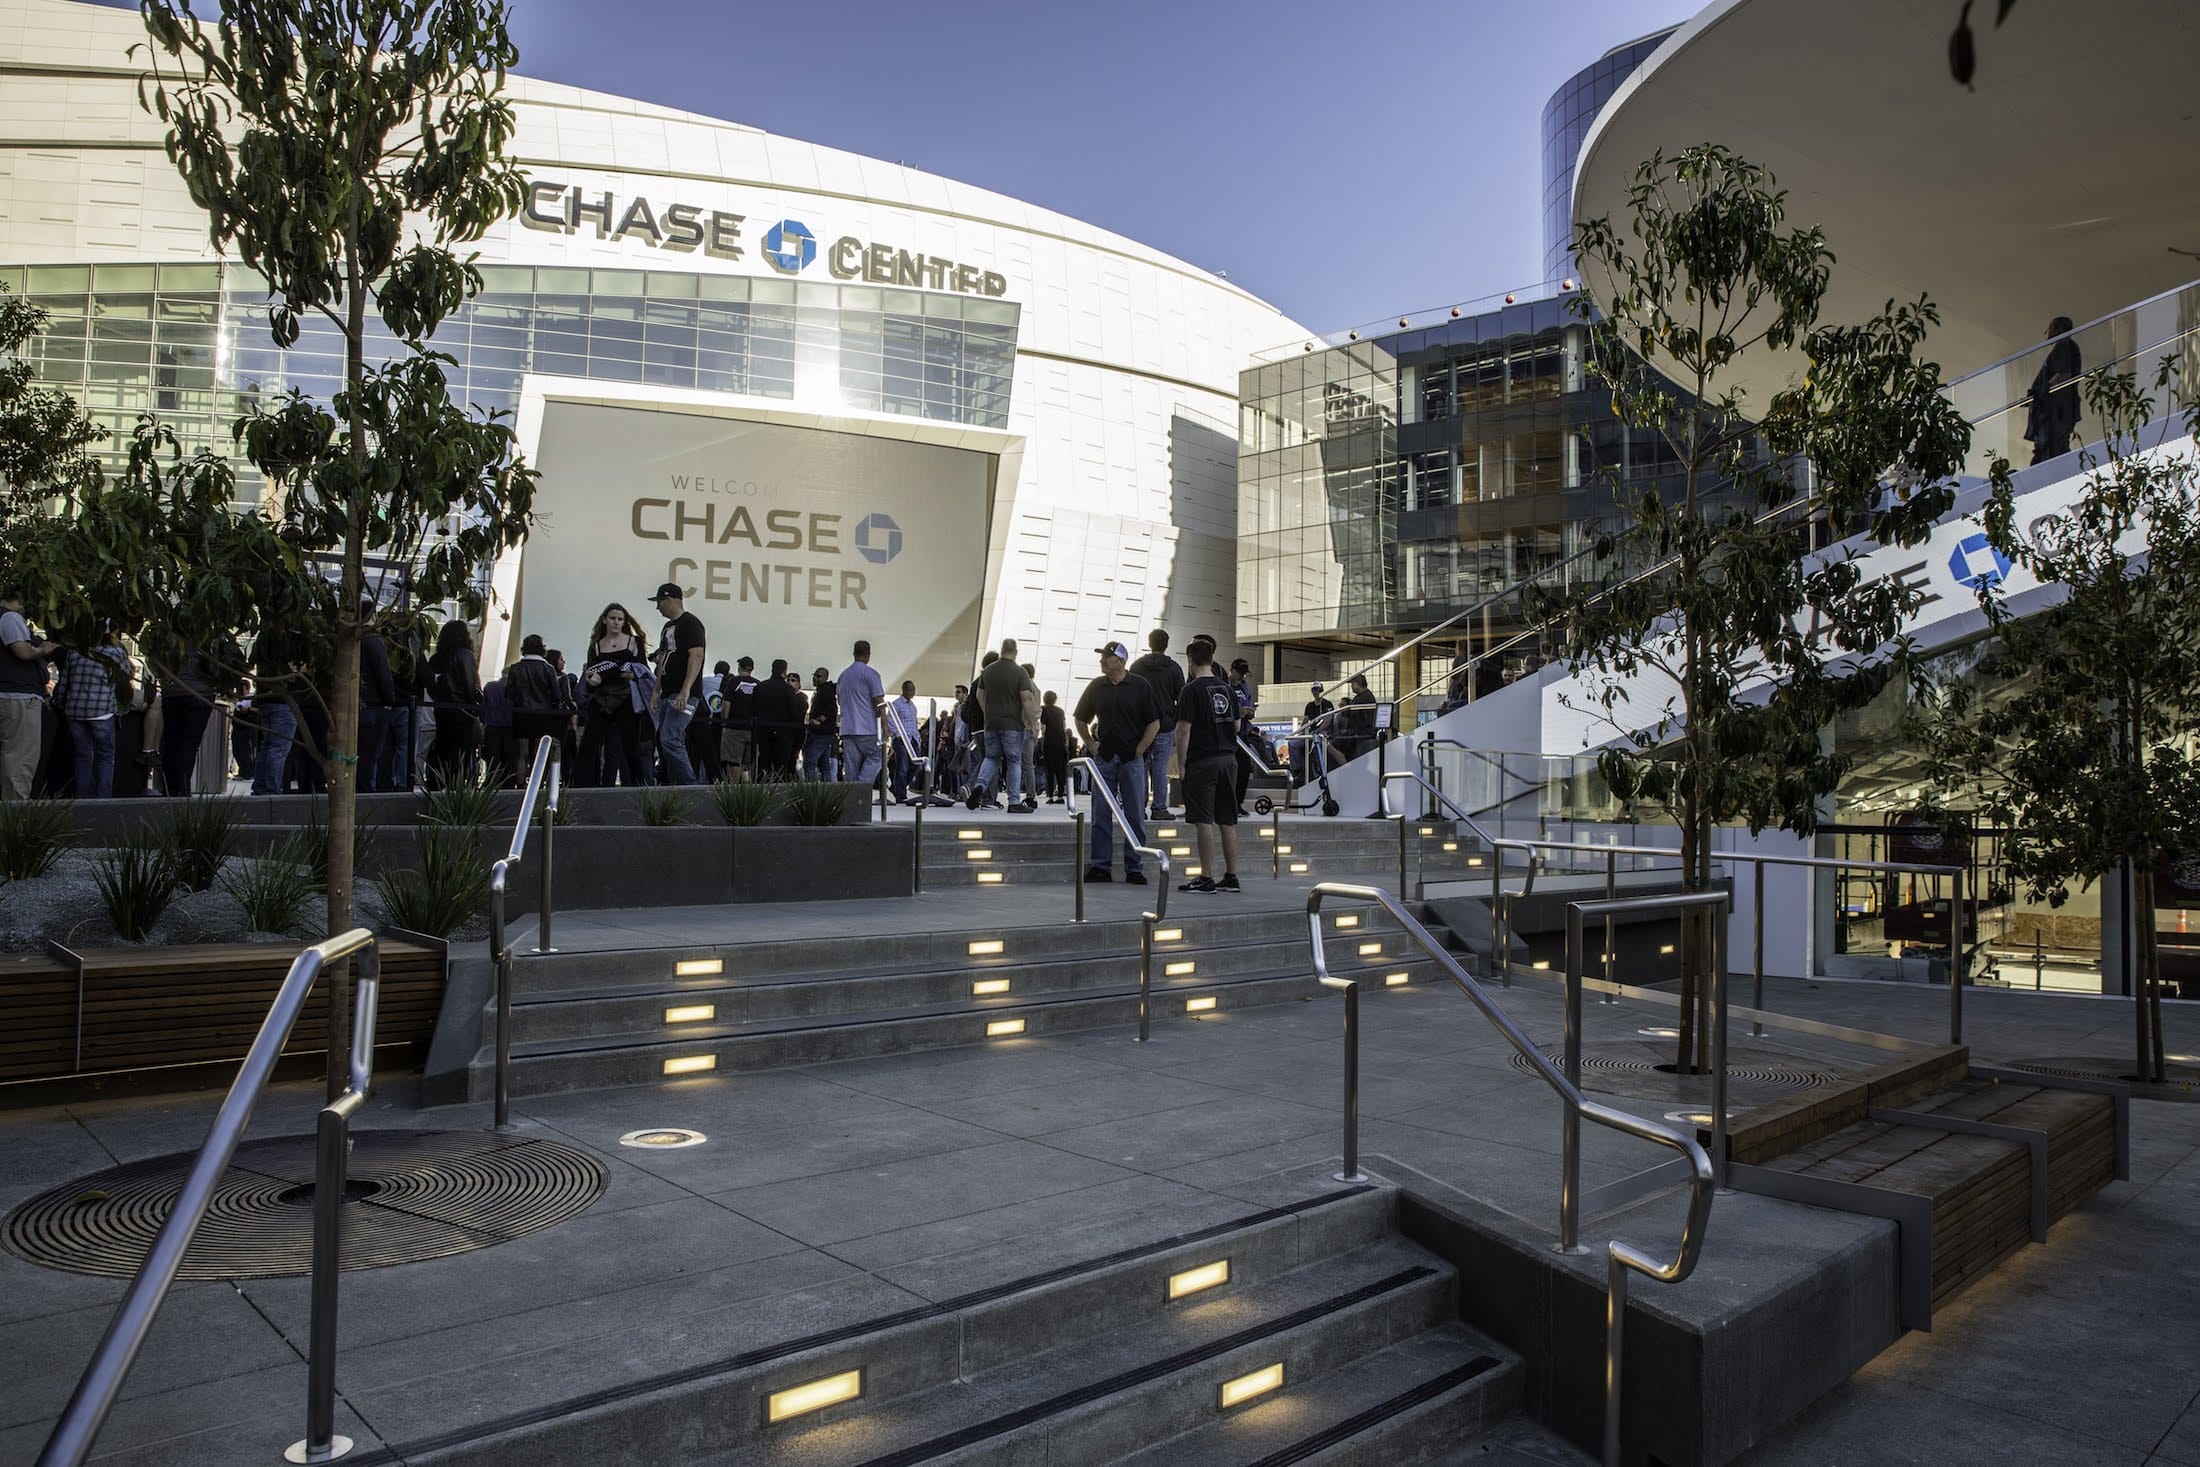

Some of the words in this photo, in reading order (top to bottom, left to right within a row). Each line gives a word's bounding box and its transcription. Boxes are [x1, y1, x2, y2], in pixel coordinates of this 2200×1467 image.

[526, 180, 746, 256] CHASE
[834, 235, 1007, 297] CENTER
[671, 475, 780, 497] WELCOM
[631, 497, 842, 554] CHASE
[668, 557, 868, 611] CENTER
